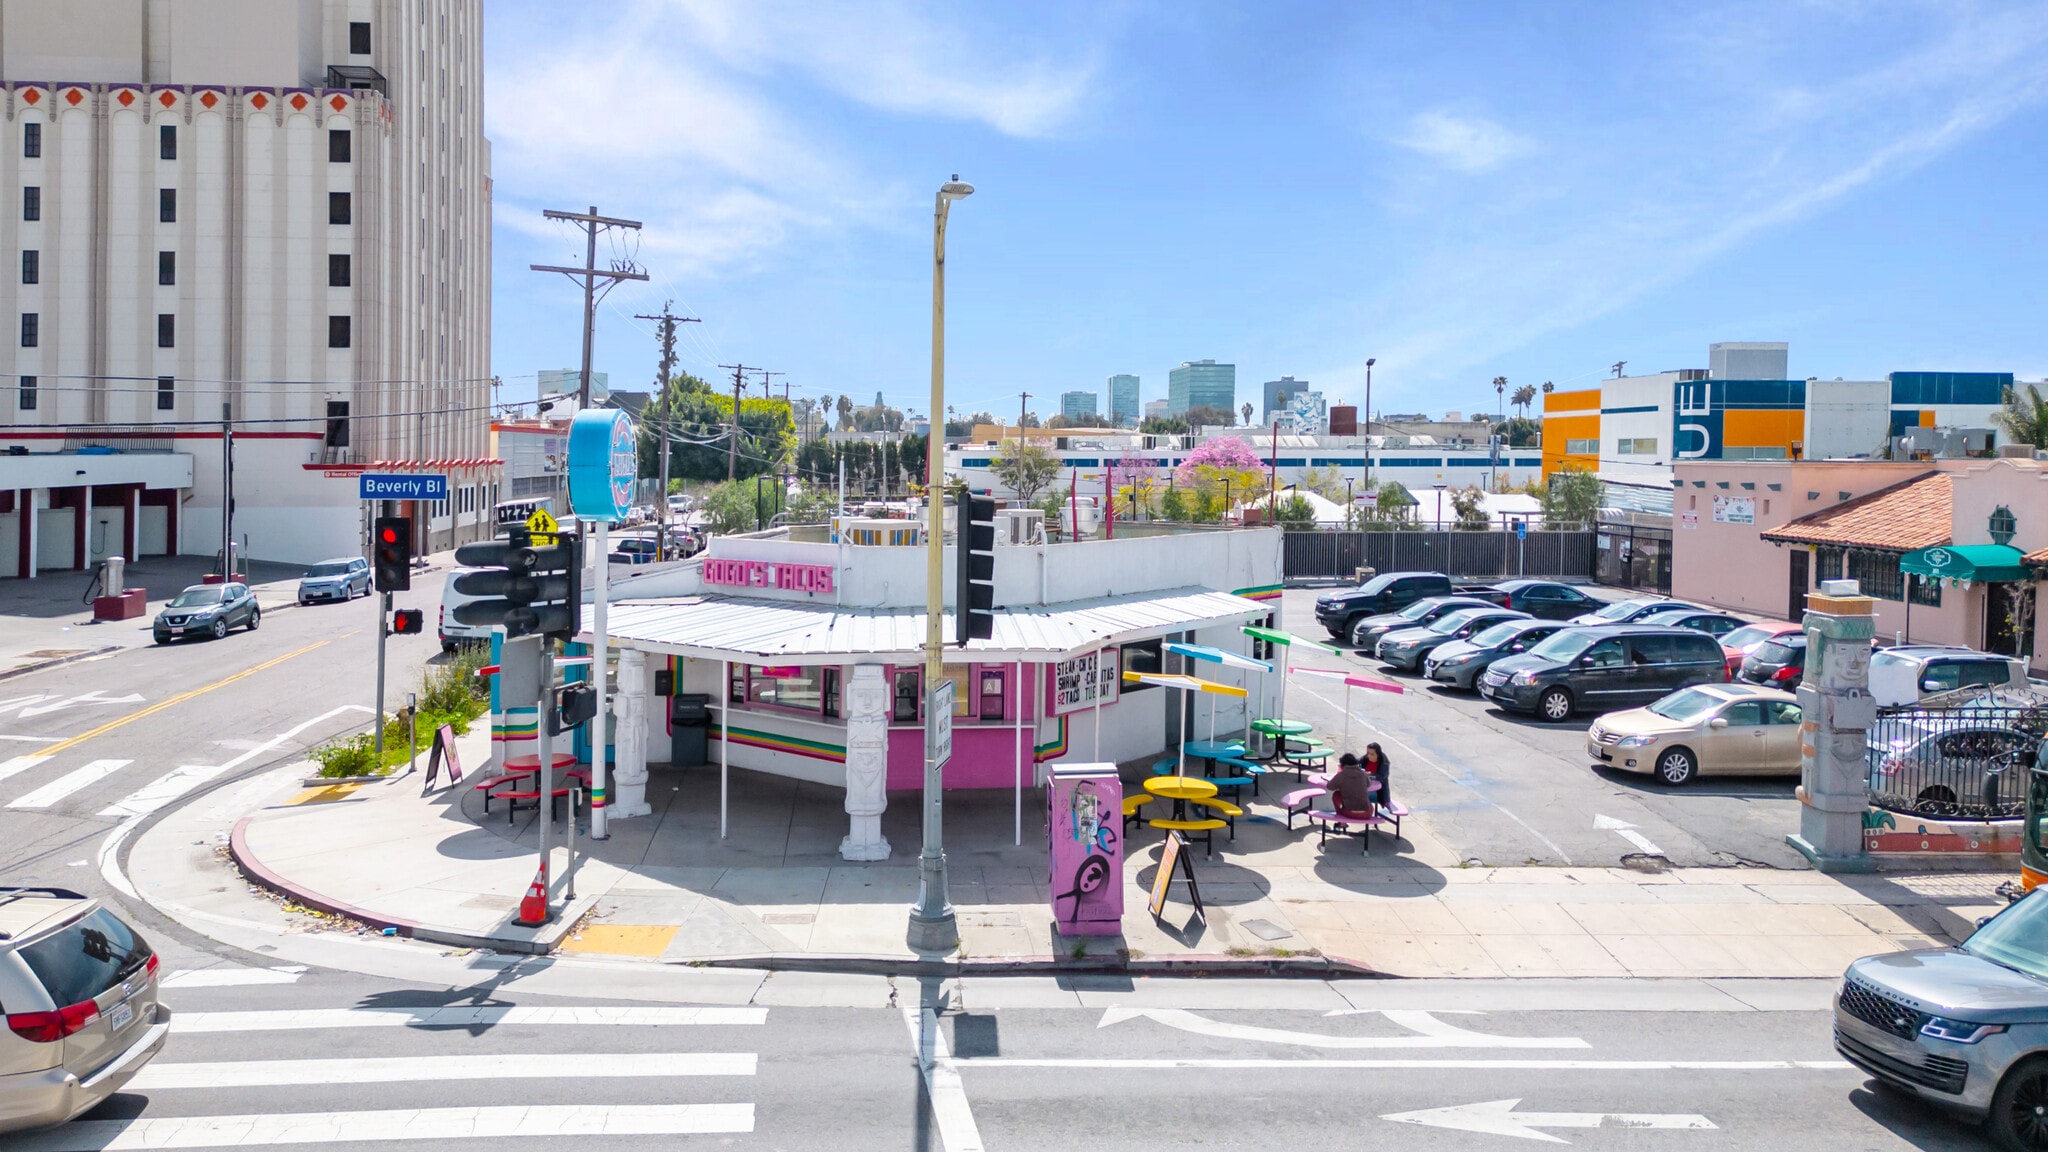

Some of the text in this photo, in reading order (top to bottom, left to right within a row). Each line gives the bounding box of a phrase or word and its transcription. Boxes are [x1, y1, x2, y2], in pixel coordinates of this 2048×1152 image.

[366, 479, 440, 496] Beverly Bl
[771, 562, 834, 594] TACOS
[1058, 673, 1081, 691] SHRIMP
[1855, 977, 1919, 1007] RANGE ROVER
